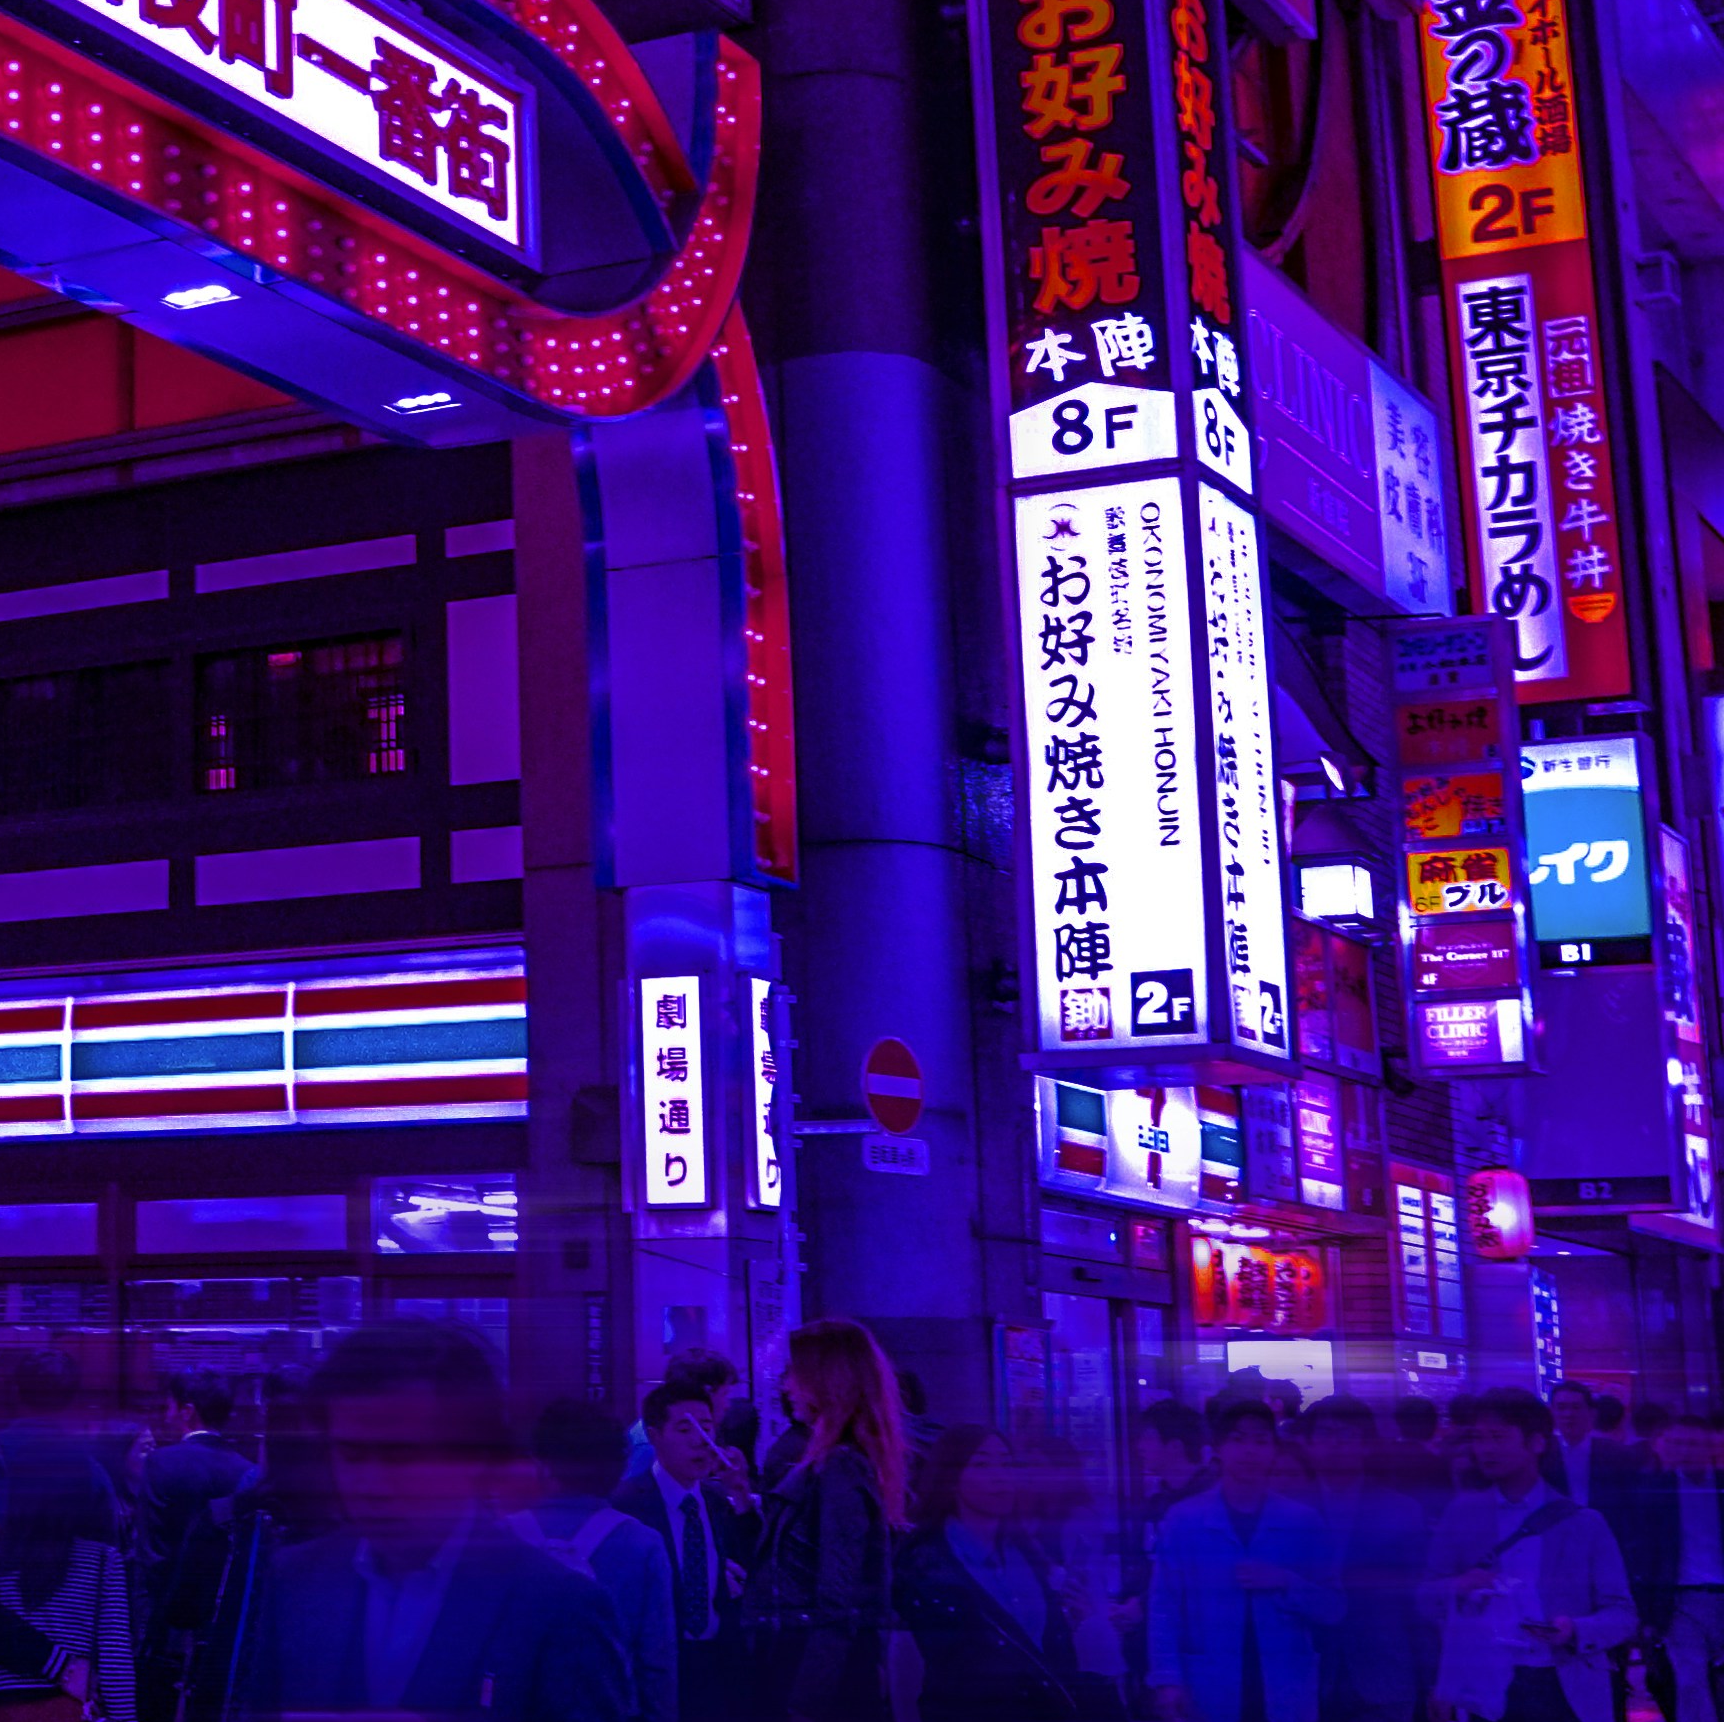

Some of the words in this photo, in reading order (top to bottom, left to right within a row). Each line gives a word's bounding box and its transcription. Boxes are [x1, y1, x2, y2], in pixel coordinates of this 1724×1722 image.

[1470, 182, 1556, 243] 2F
[1025, 313, 1156, 382] 本陣
[1051, 399, 1139, 457] 8F
[1203, 397, 1236, 468] 8F
[1544, 319, 1611, 592] 元祖焼き牛丼
[1464, 285, 1554, 672] 東京チカラめし
[1139, 501, 1174, 717] OKONOMIYAKI
[1039, 554, 1114, 983] お好み焼き本陣
[1152, 726, 1180, 847] HONJIN
[1542, 755, 1611, 773] 新生銀行
[1419, 853, 1497, 883] 麻雀
[1446, 883, 1504, 907] ブル
[1560, 943, 1592, 962] B1
[1135, 981, 1192, 1025] 2F
[1426, 1006, 1487, 1022] FILLER
[1426, 1023, 1487, 1038] CLINIC
[656, 993, 691, 1188] 劇場通り
